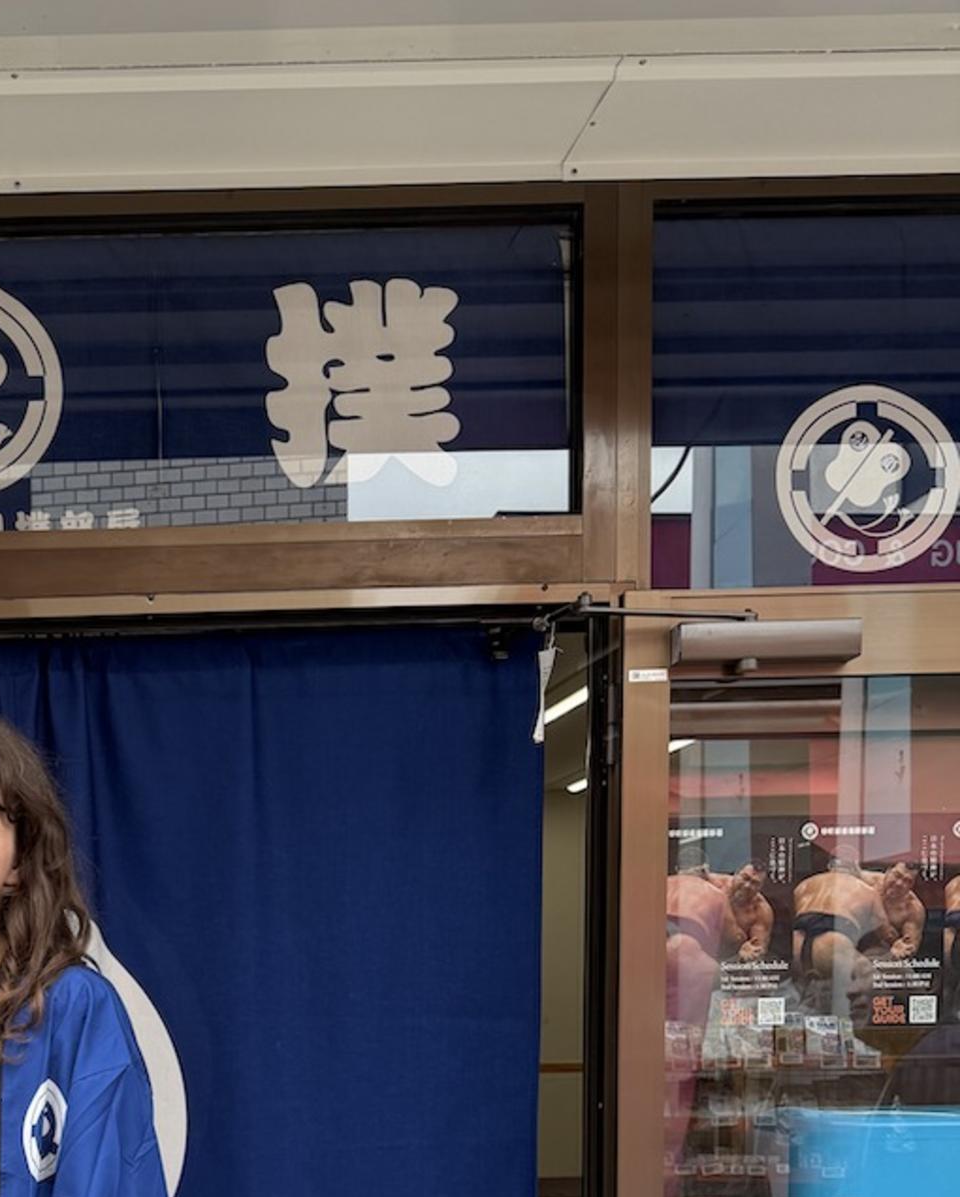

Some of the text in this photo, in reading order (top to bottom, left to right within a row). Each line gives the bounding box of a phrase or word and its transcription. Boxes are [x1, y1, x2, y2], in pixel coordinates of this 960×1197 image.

[265, 278, 461, 488] 撲
[873, 996, 894, 1006] GET
[873, 1005, 904, 1015] YOUR
[873, 1015, 906, 1024] GUIDE
